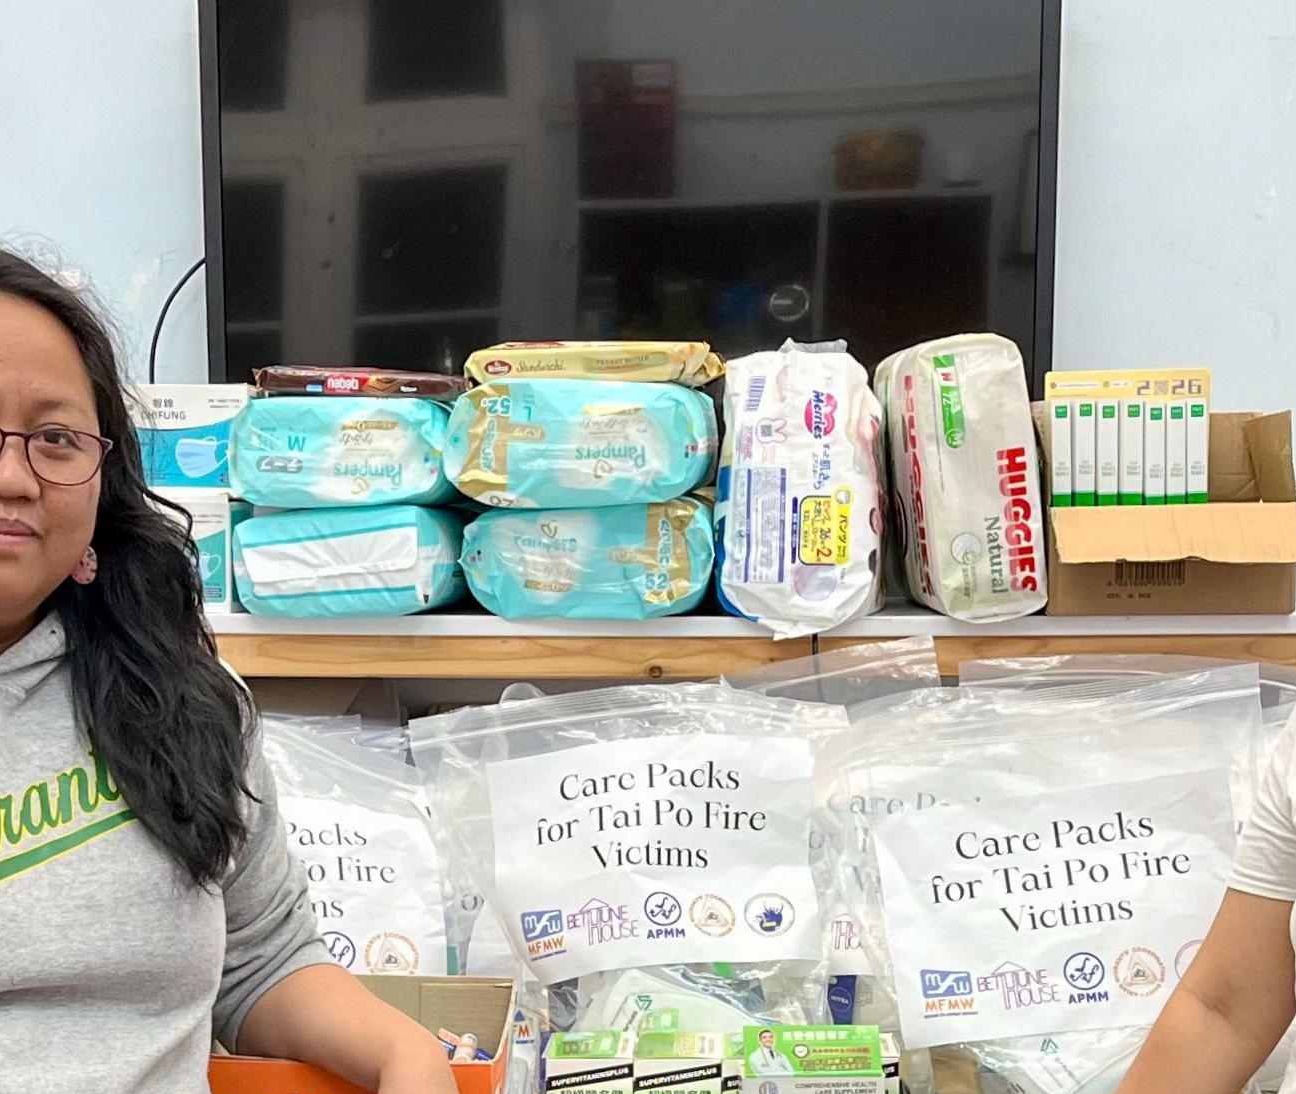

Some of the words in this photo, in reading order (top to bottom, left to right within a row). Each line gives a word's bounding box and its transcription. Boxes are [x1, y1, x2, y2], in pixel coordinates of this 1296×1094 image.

[812, 390, 825, 440] Merries
[575, 446, 647, 468] Pampers
[334, 462, 402, 486] Pampers
[996, 446, 1038, 593] HUGGIES
[984, 516, 1009, 595] Natural
[560, 771, 635, 801] Care
[646, 760, 740, 791] Packs
[535, 818, 580, 846] for
[589, 802, 642, 832] Tai
[654, 799, 693, 828] Po
[703, 801, 766, 832] Fire
[956, 830, 1041, 860] Care
[1050, 811, 1154, 849] Packs
[338, 857, 396, 884] Fire
[592, 840, 709, 869] Victims
[932, 875, 984, 904] for
[993, 866, 1054, 896] Tai
[1063, 858, 1110, 887] Po
[1120, 850, 1192, 881] Fire
[999, 898, 1135, 933] Victims
[528, 938, 565, 955] MFMW
[646, 928, 686, 940] APMM
[925, 997, 974, 1013] MFMW
[1068, 990, 1109, 1005] APMM
